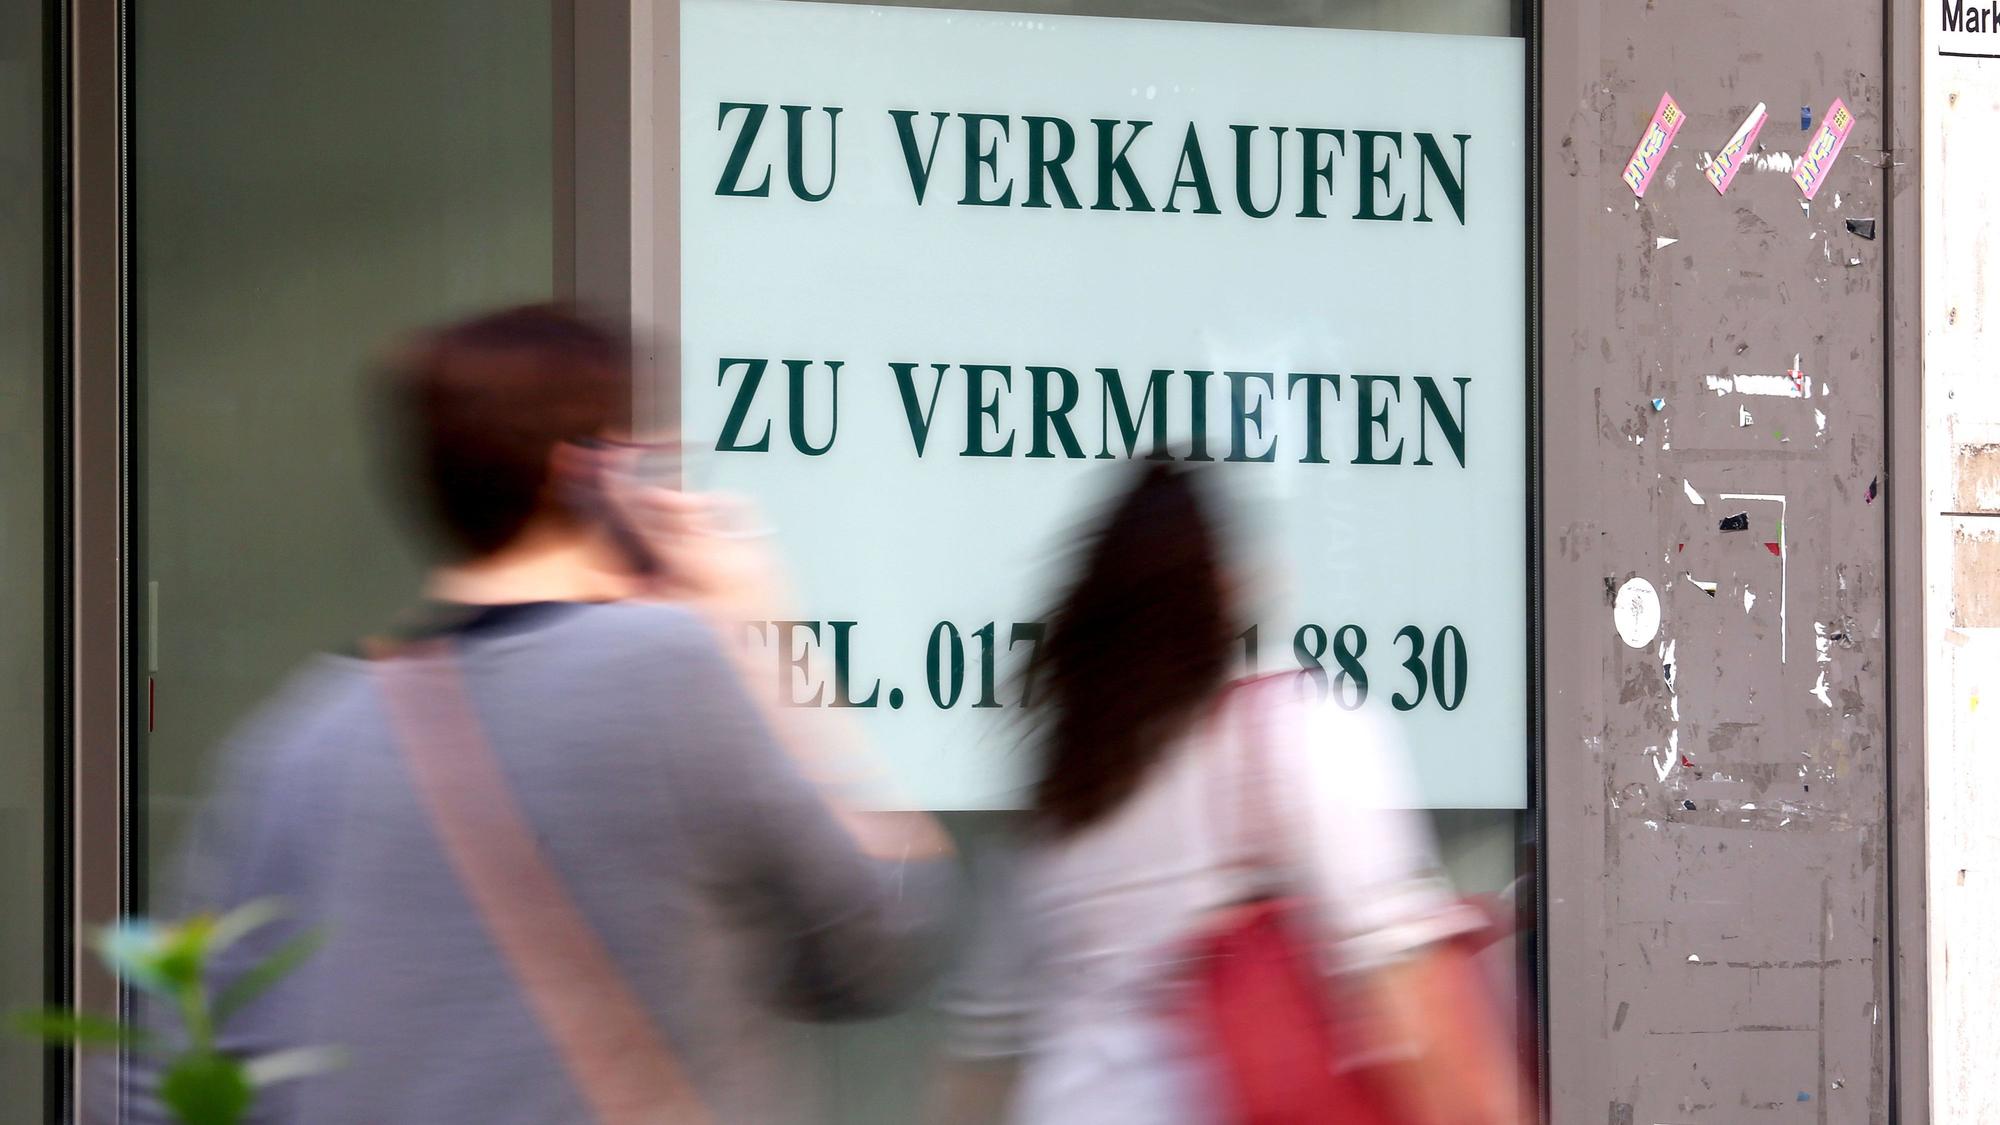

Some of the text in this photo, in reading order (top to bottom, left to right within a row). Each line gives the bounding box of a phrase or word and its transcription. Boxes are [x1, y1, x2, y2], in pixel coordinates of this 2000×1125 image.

[715, 102, 1472, 226] ZU VERKAUFEN
[715, 358, 1472, 469] ZU VERMIETEN
[1292, 623, 1368, 712] 88
[1392, 624, 1469, 713] 30
